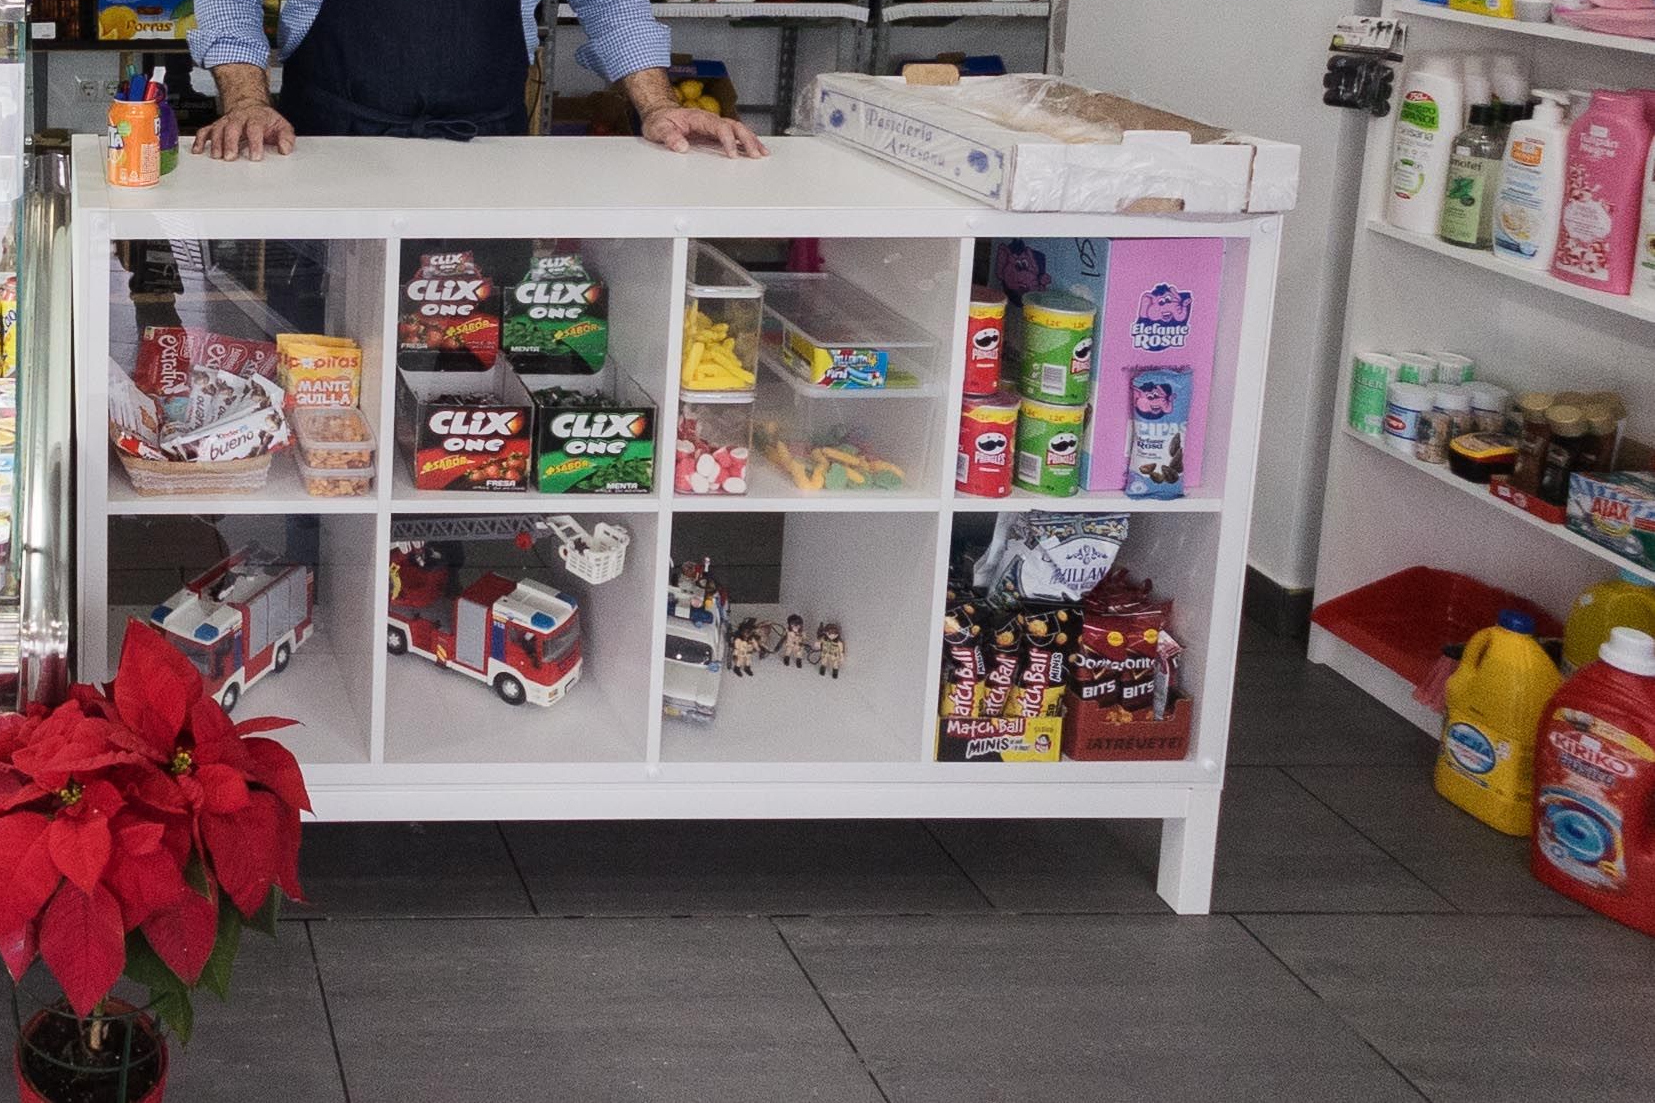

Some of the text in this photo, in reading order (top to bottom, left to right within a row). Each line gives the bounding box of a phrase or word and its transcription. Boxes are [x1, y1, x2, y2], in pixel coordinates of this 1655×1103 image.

[1131, 323, 1190, 337] Elefante
[1132, 334, 1186, 349] Rosa
[209, 429, 255, 461] bueno
[974, 451, 1006, 465] PRINGLES
[1592, 498, 1631, 520] AJAX
[949, 680, 975, 717] atch
[1082, 680, 1117, 698] BITS
[1123, 681, 1155, 699] BITS
[984, 685, 1008, 716] atch
[1018, 684, 1044, 717] atch
[947, 720, 995, 737] Match
[998, 718, 1024, 734] Ball
